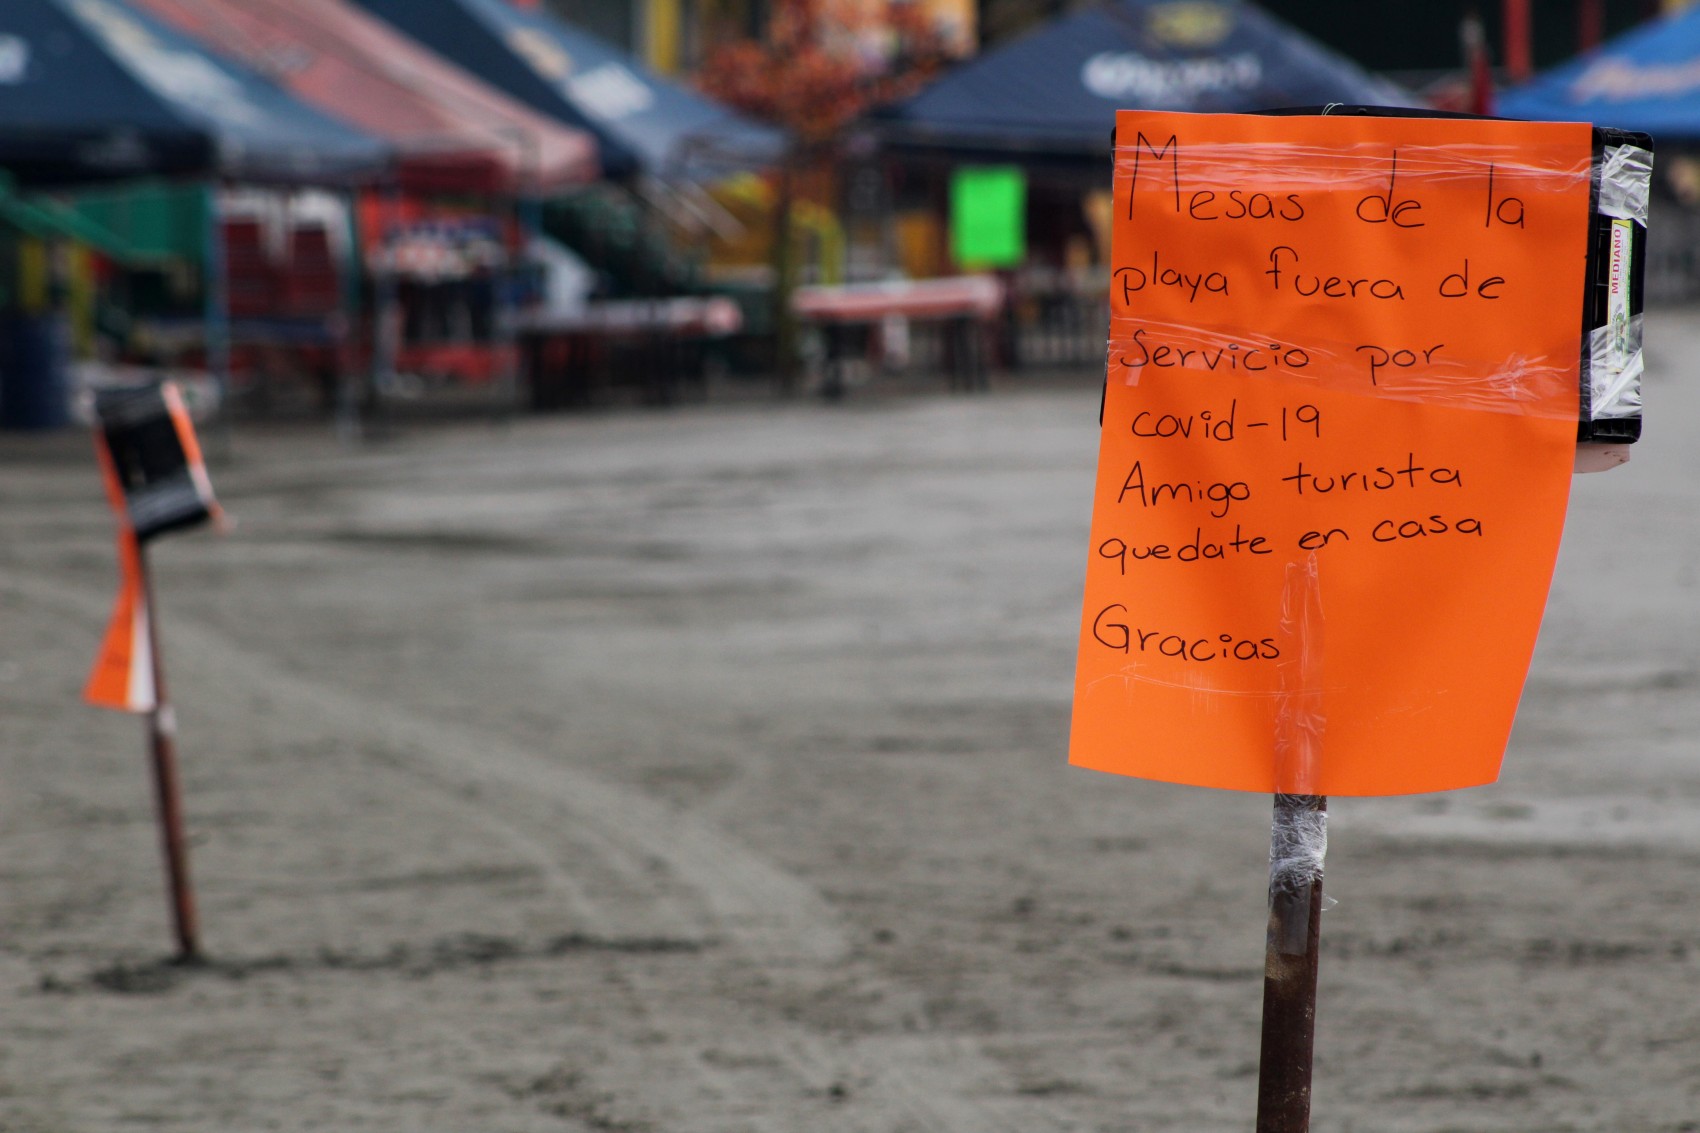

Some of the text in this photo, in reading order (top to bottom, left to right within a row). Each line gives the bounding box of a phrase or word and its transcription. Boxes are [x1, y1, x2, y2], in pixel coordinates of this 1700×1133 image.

[1128, 131, 1525, 230] Mesas de la
[1113, 246, 1507, 306] playa fuera de
[1611, 228, 1622, 295] MEDIANO
[1355, 344, 1445, 386] por
[1131, 398, 1321, 443] covid-19
[1117, 452, 1463, 519] Amigo turista
[1098, 513, 1484, 576] quedate en casa
[1092, 603, 1281, 662] Gracias
